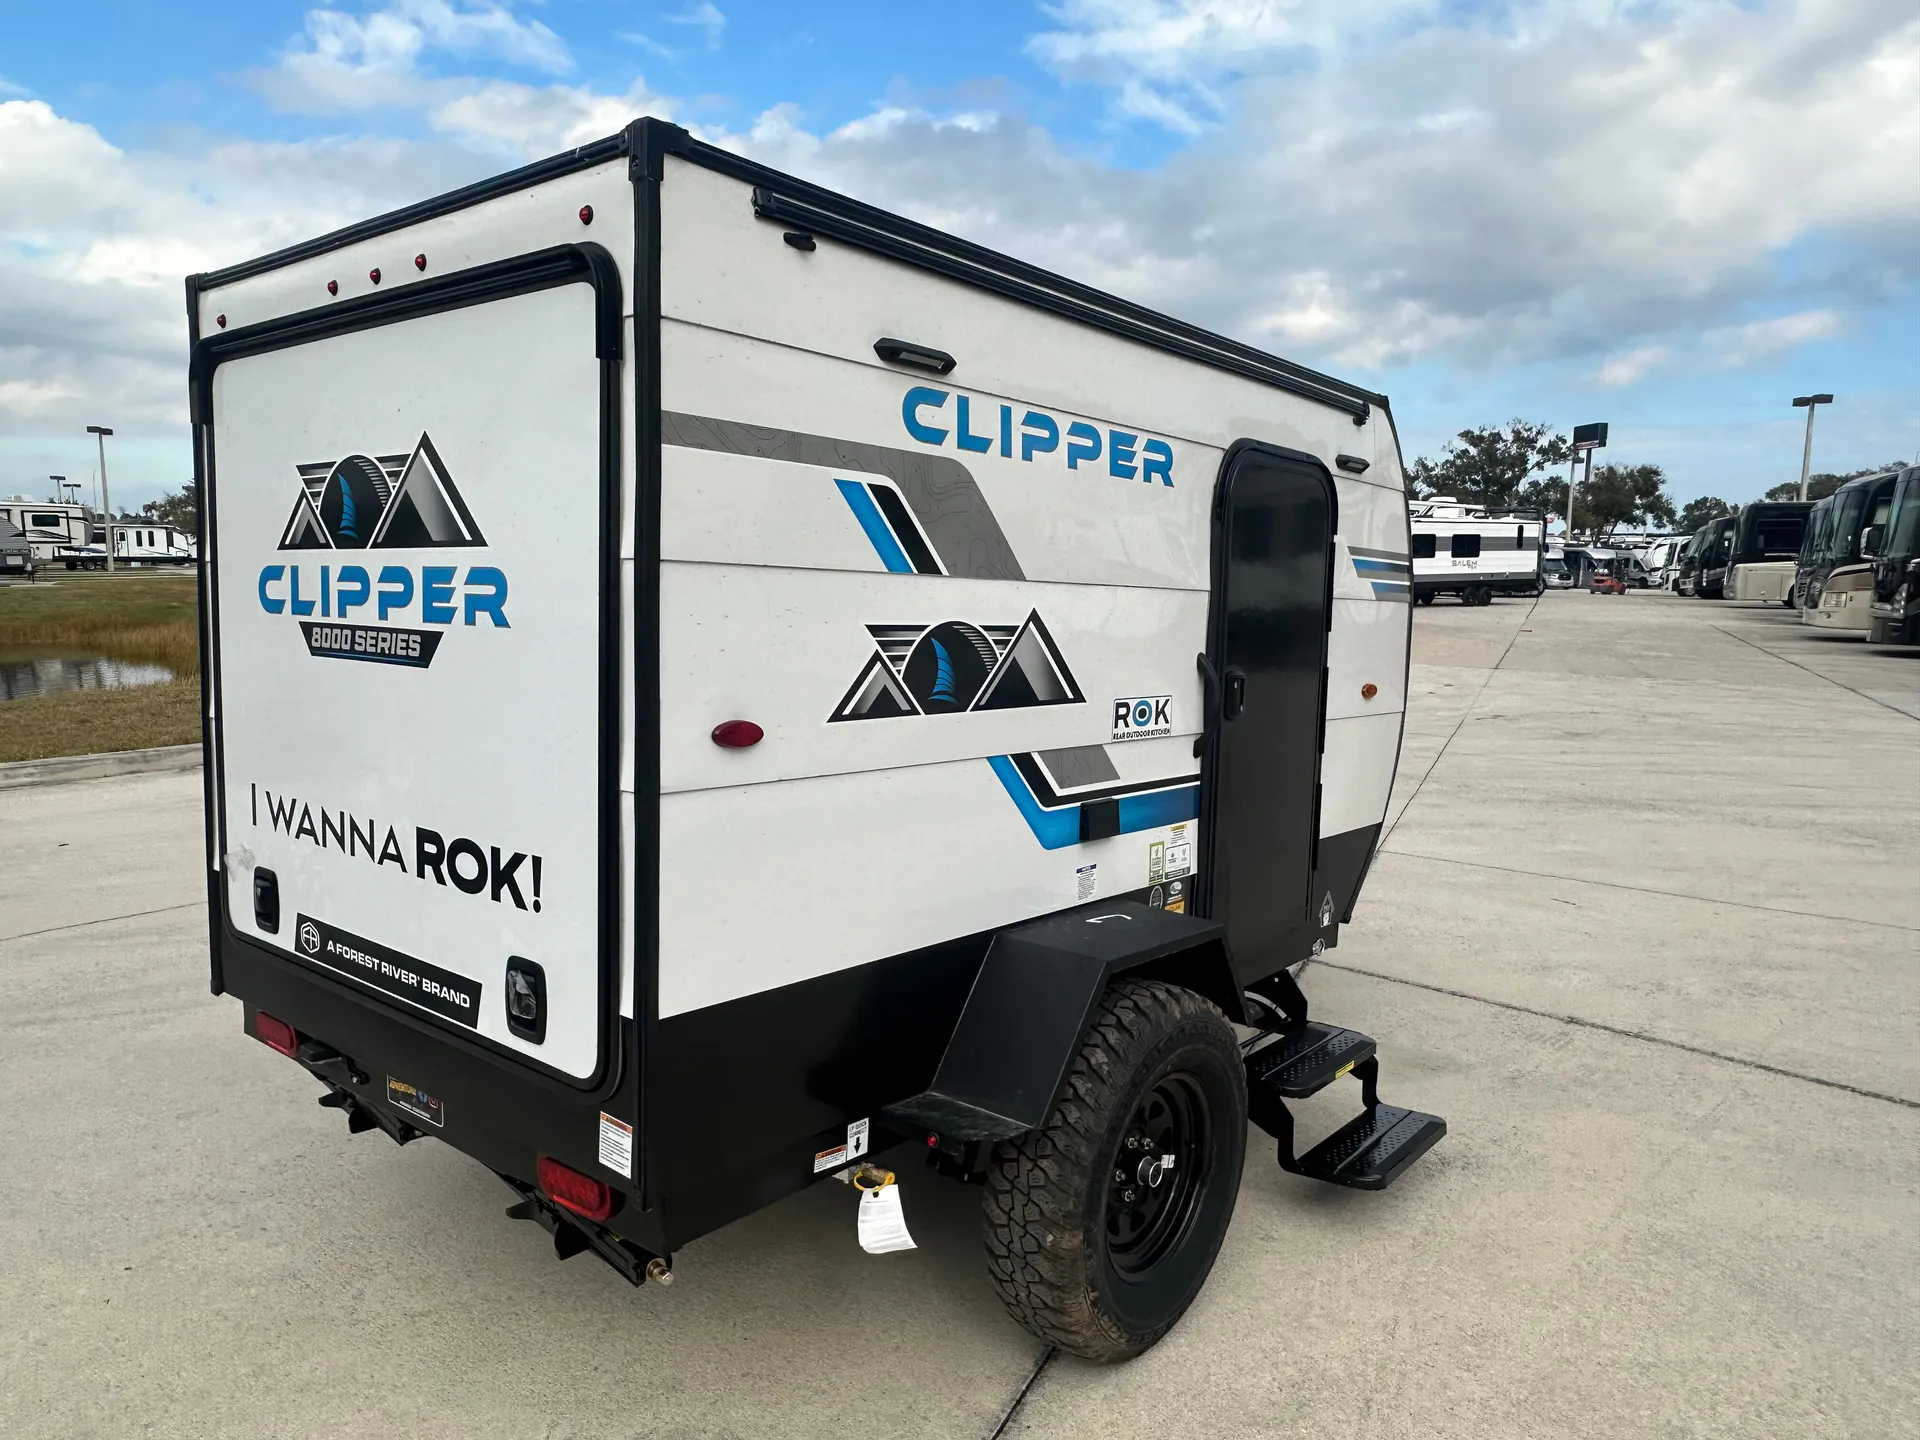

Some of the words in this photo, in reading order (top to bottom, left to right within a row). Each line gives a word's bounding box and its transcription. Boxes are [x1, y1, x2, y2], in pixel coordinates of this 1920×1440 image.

[902, 386, 1175, 488] CLIPPER
[258, 565, 511, 628] CLIPPER
[311, 627, 352, 650] 8000
[354, 630, 421, 657] SERIES
[1114, 699, 1171, 729] ROK
[1126, 729, 1150, 739] OUTDOOR
[1151, 728, 1170, 737] KITCHEN
[251, 783, 257, 826] I
[265, 790, 408, 873] WANNA
[416, 826, 543, 914] ROK!
[327, 940, 336, 953] A
[336, 943, 379, 971] FOREST
[422, 979, 470, 1008] BRAND
